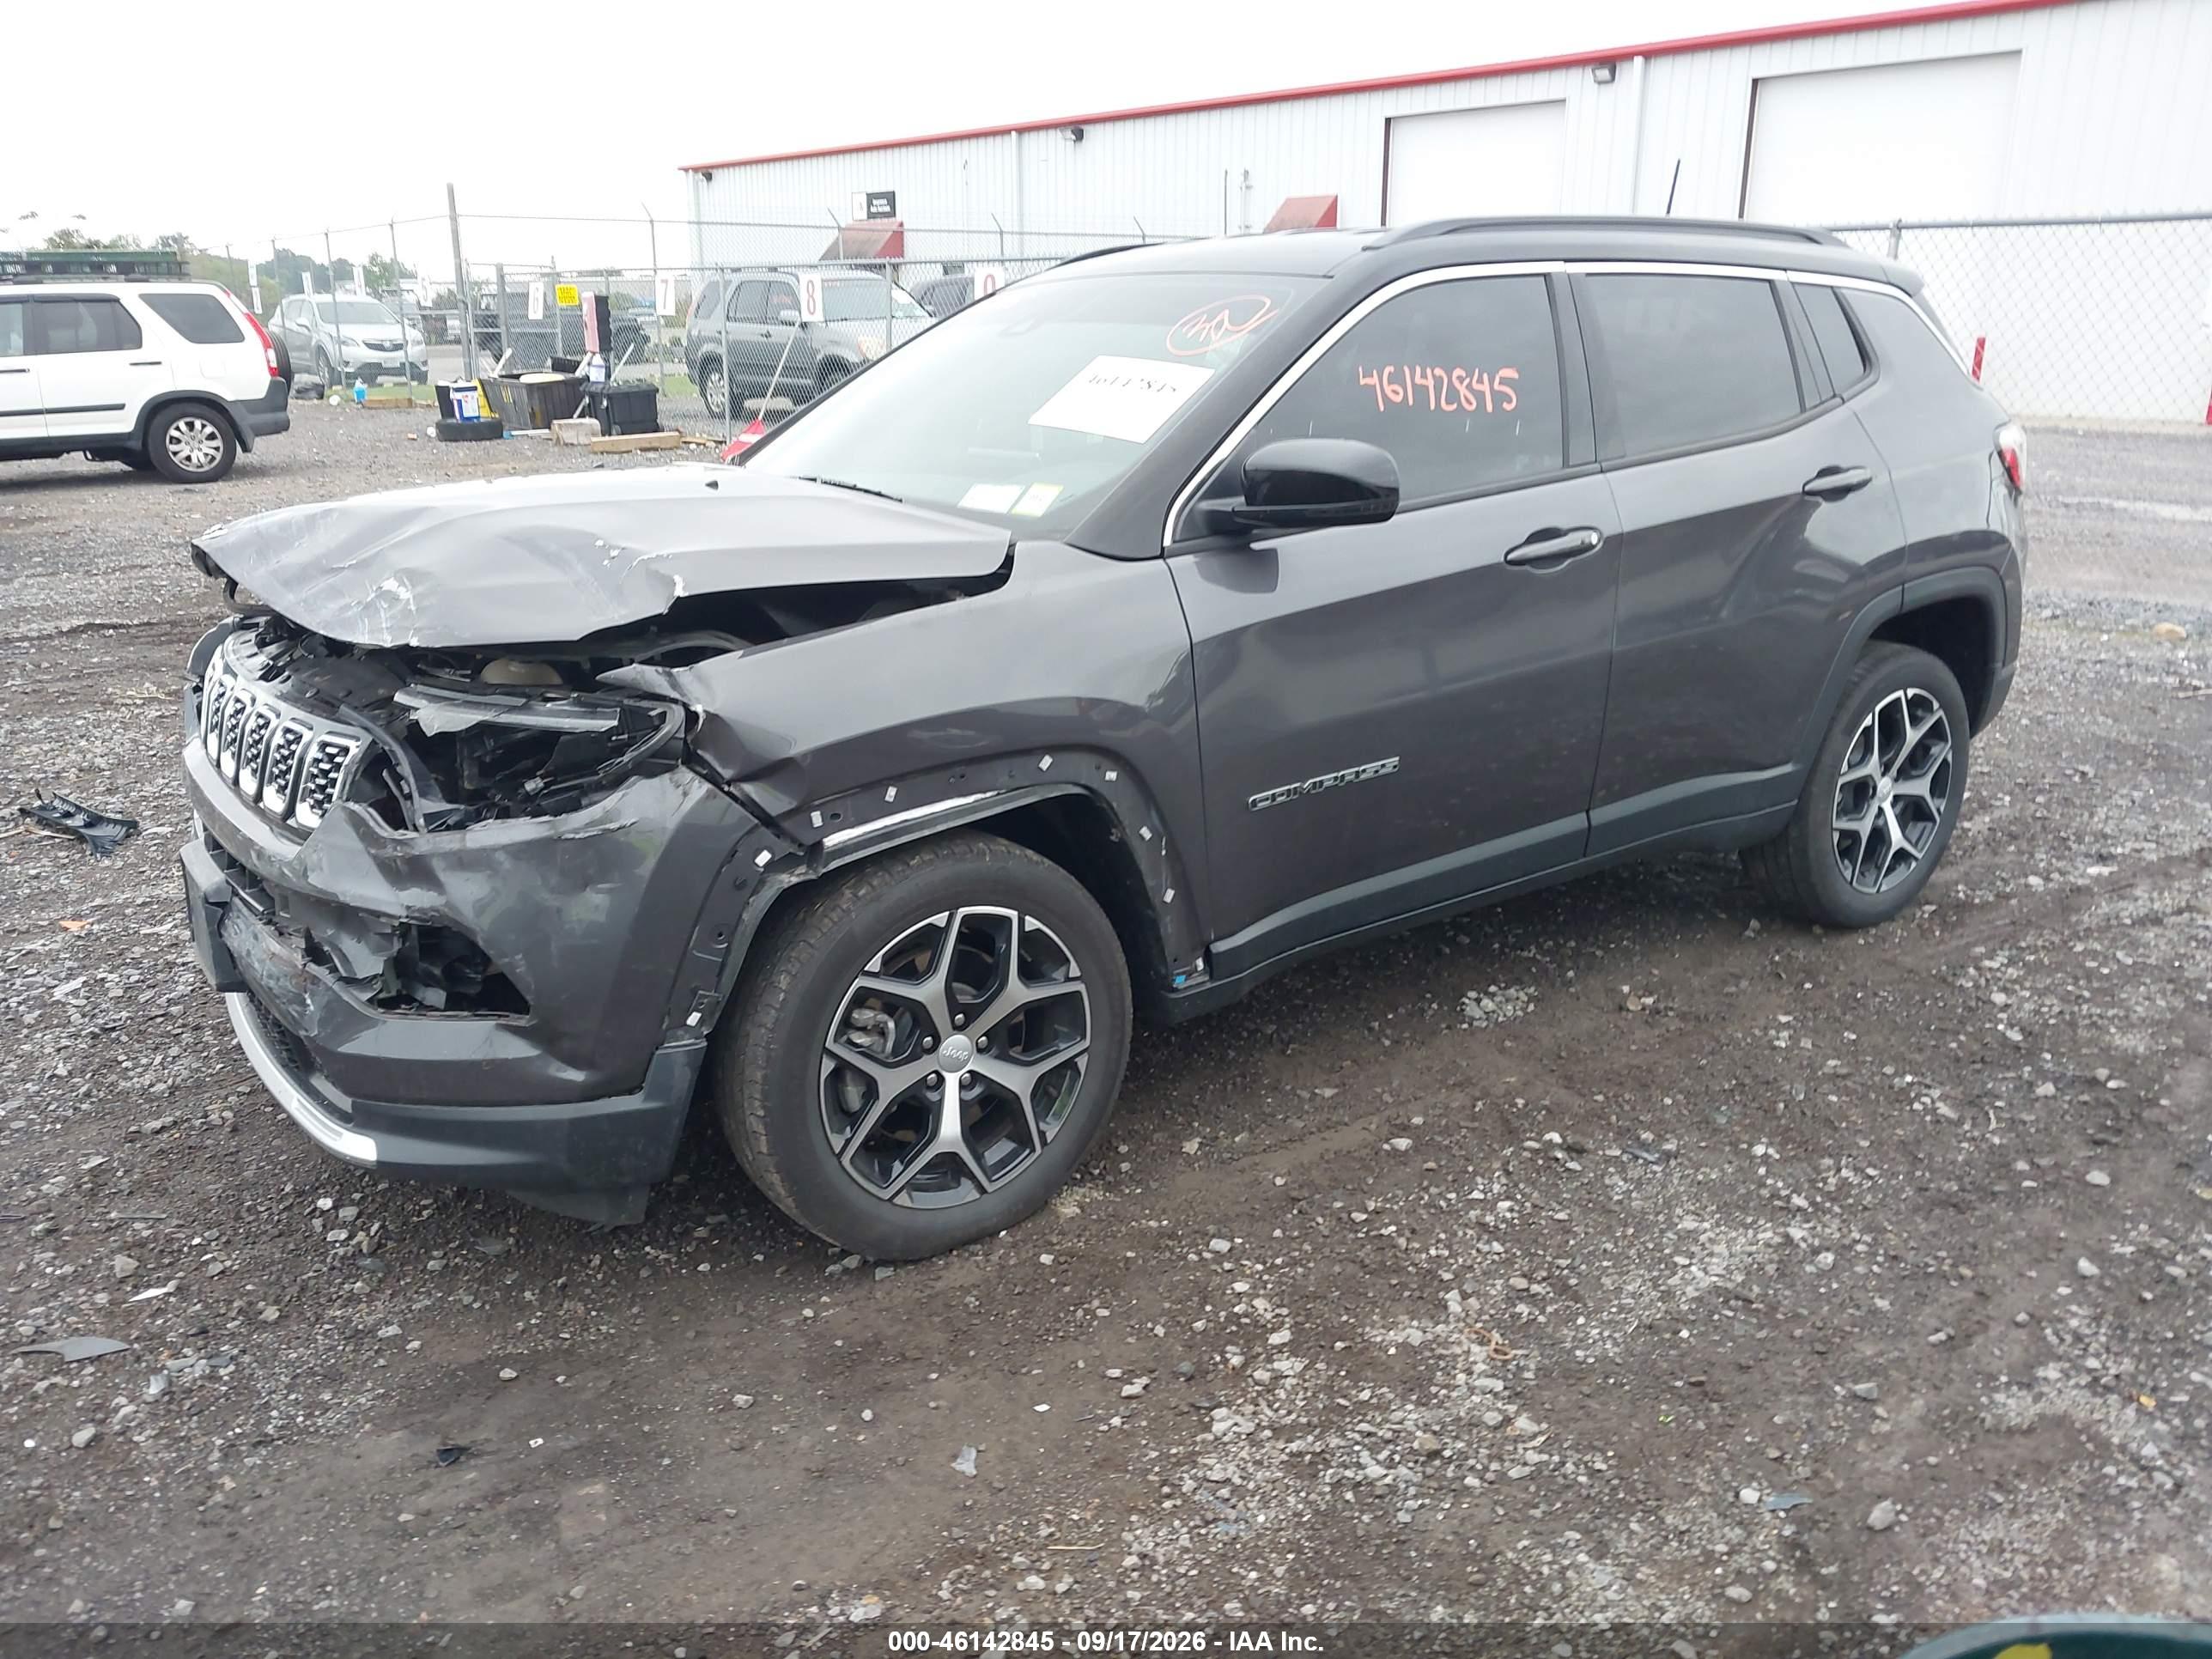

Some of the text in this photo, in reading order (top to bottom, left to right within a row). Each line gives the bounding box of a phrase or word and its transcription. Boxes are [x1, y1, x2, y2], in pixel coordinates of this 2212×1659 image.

[660, 279, 669, 310] 7
[806, 279, 817, 316] 8
[1358, 365, 1519, 412] 46142845
[1248, 756, 1401, 811] COMPASS
[942, 1046, 969, 1062] Jeep
